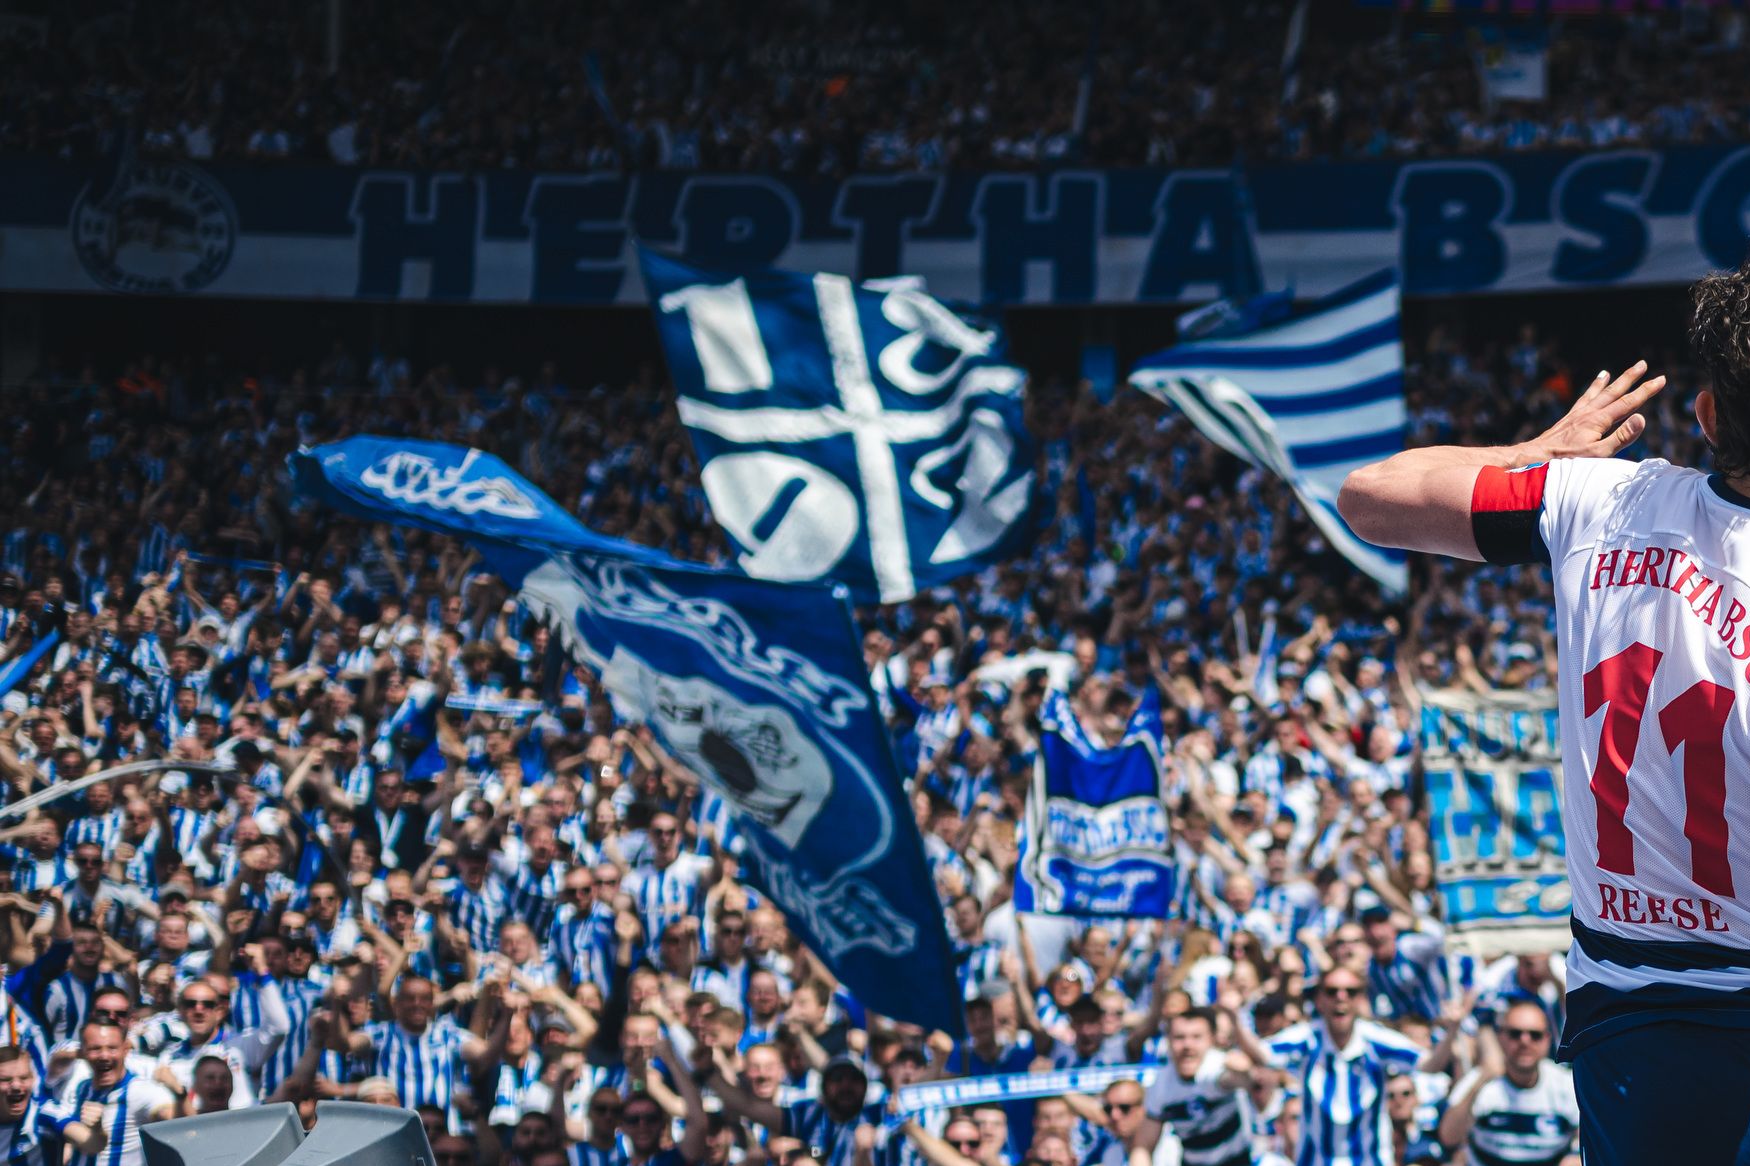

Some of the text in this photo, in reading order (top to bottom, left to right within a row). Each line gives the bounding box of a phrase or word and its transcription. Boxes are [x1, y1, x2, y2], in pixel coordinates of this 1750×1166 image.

[350, 170, 1260, 304] HERTHA
[1590, 546, 1724, 627] HERTHA
[1583, 641, 1736, 898] 11
[1597, 882, 1730, 933] REESE
